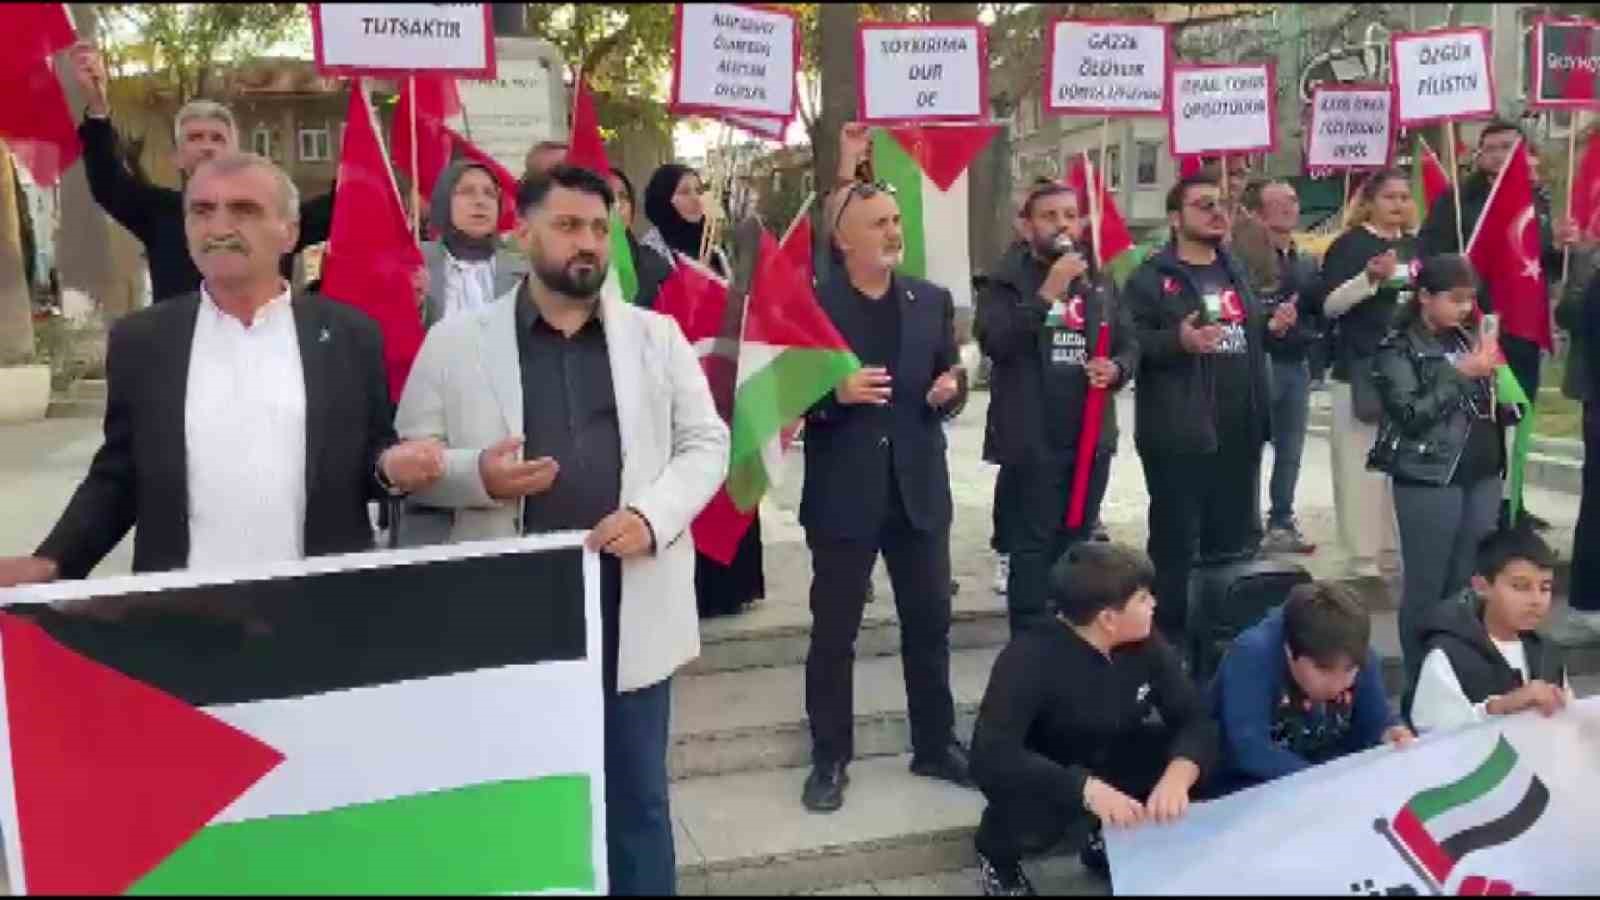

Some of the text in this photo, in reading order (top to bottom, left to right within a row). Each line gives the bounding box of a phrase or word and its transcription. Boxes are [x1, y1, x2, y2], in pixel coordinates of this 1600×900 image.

[362, 17, 462, 39] TUTSAKTIR
[880, 38, 968, 54] SOYKIRIMA
[908, 64, 943, 80] DUR
